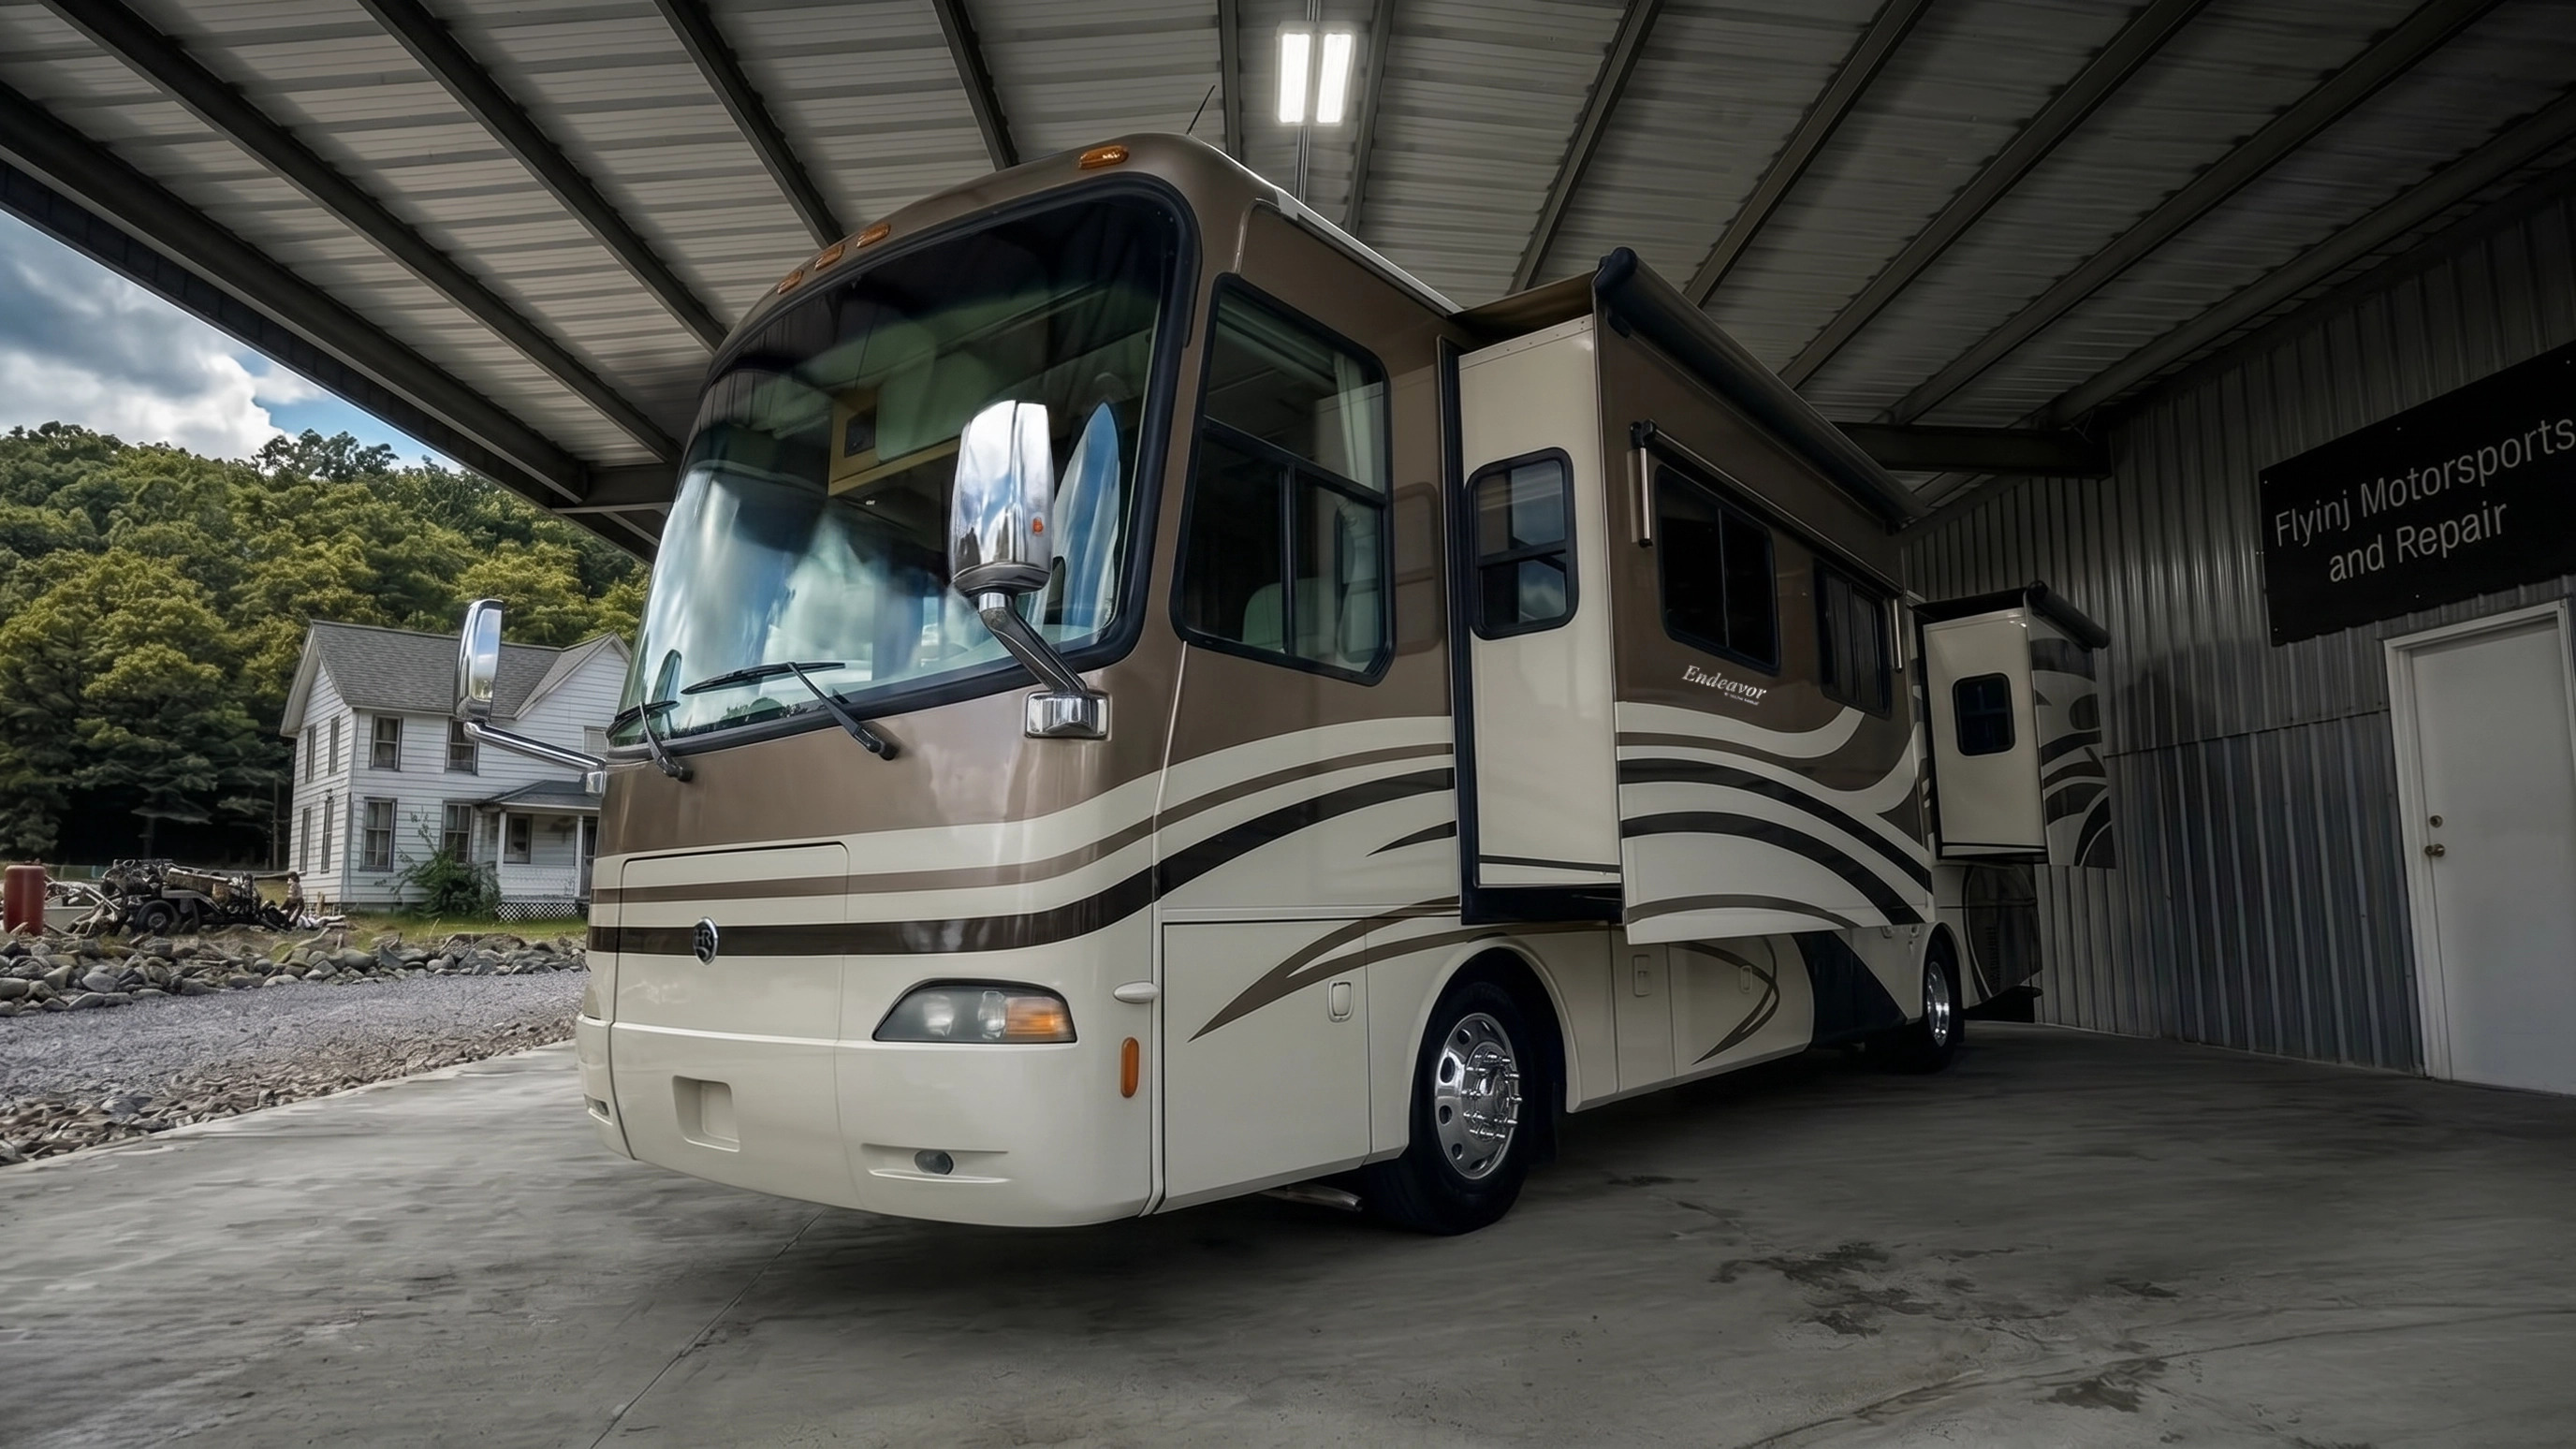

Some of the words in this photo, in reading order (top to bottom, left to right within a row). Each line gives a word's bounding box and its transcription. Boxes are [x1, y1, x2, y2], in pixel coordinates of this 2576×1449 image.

[2276, 489, 2350, 548] Flyinj
[2361, 418, 2576, 518] Motorsports
[2329, 534, 2385, 582] and
[2396, 500, 2507, 564] Repair
[1682, 665, 1767, 699] Endeavor
